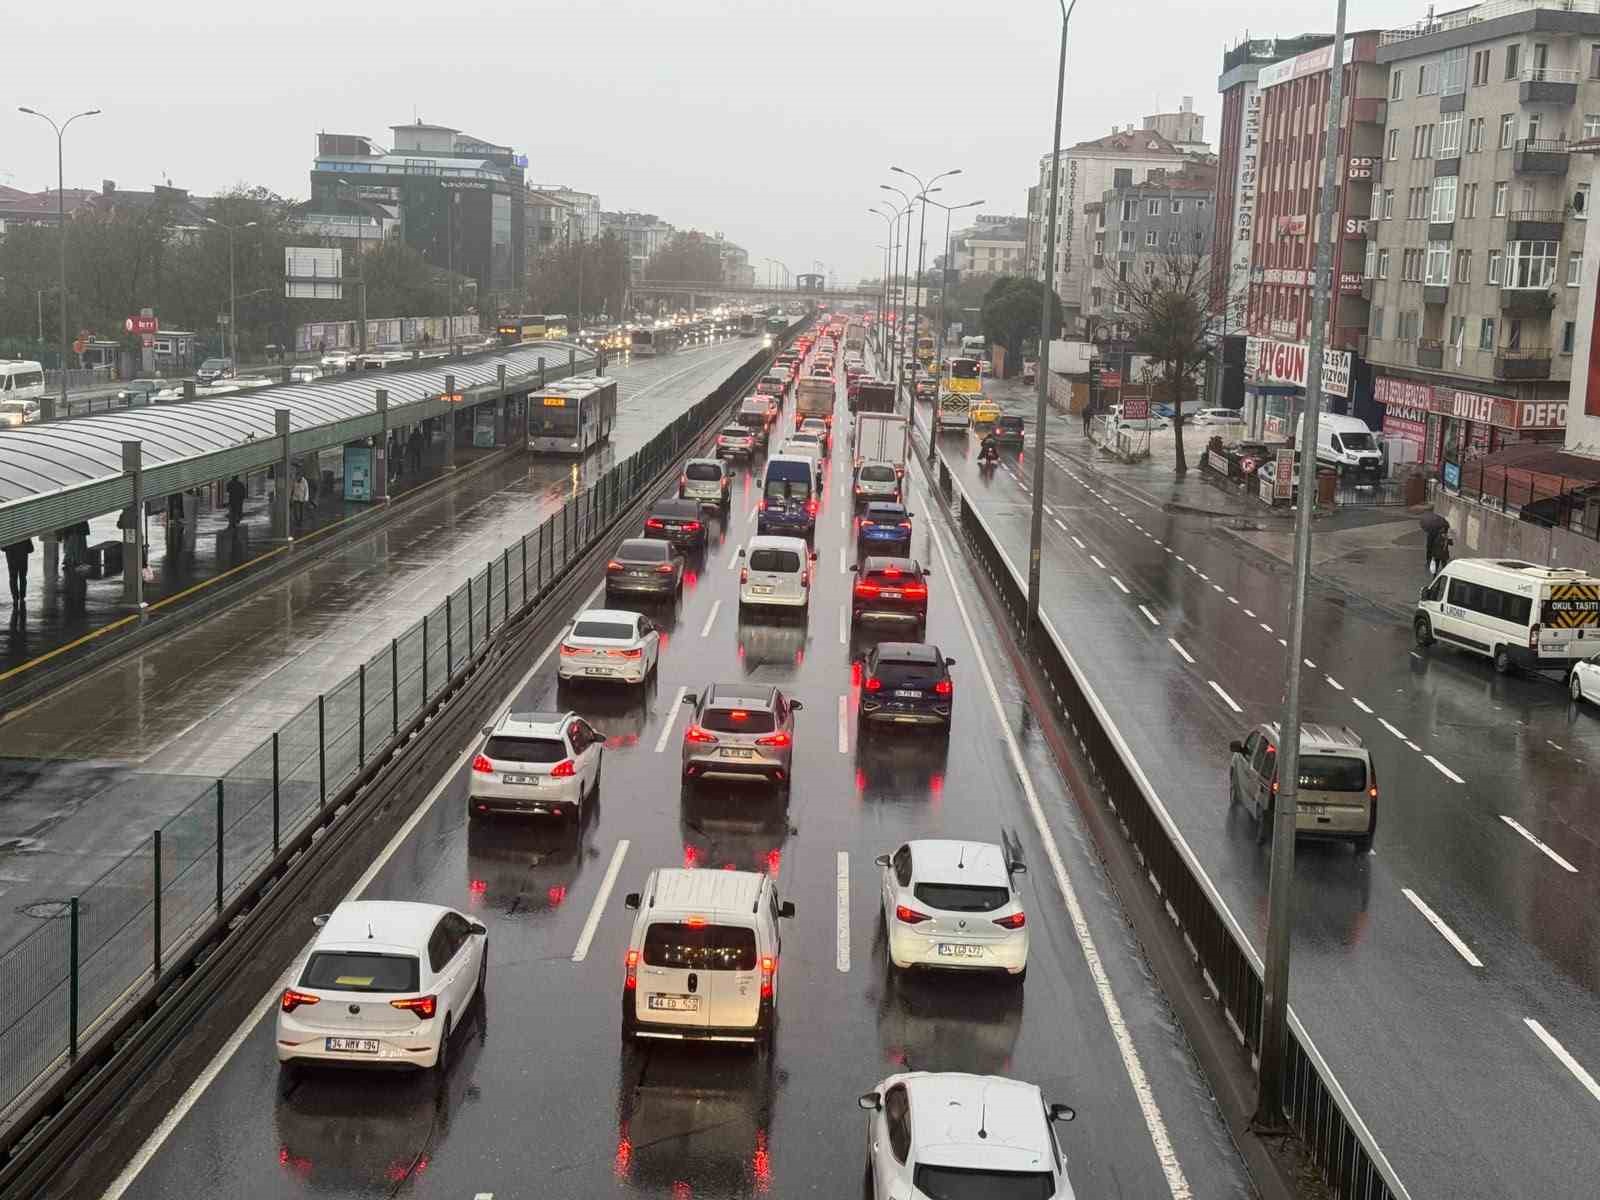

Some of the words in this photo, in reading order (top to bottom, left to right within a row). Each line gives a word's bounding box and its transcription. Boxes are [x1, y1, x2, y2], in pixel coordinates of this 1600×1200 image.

[1260, 341, 1305, 384] UYGUN
[1454, 392, 1494, 421] OUTLET
[1522, 404, 1568, 427] DEFO
[1552, 601, 1572, 611] OKUL
[332, 1039, 342, 1049] 34
